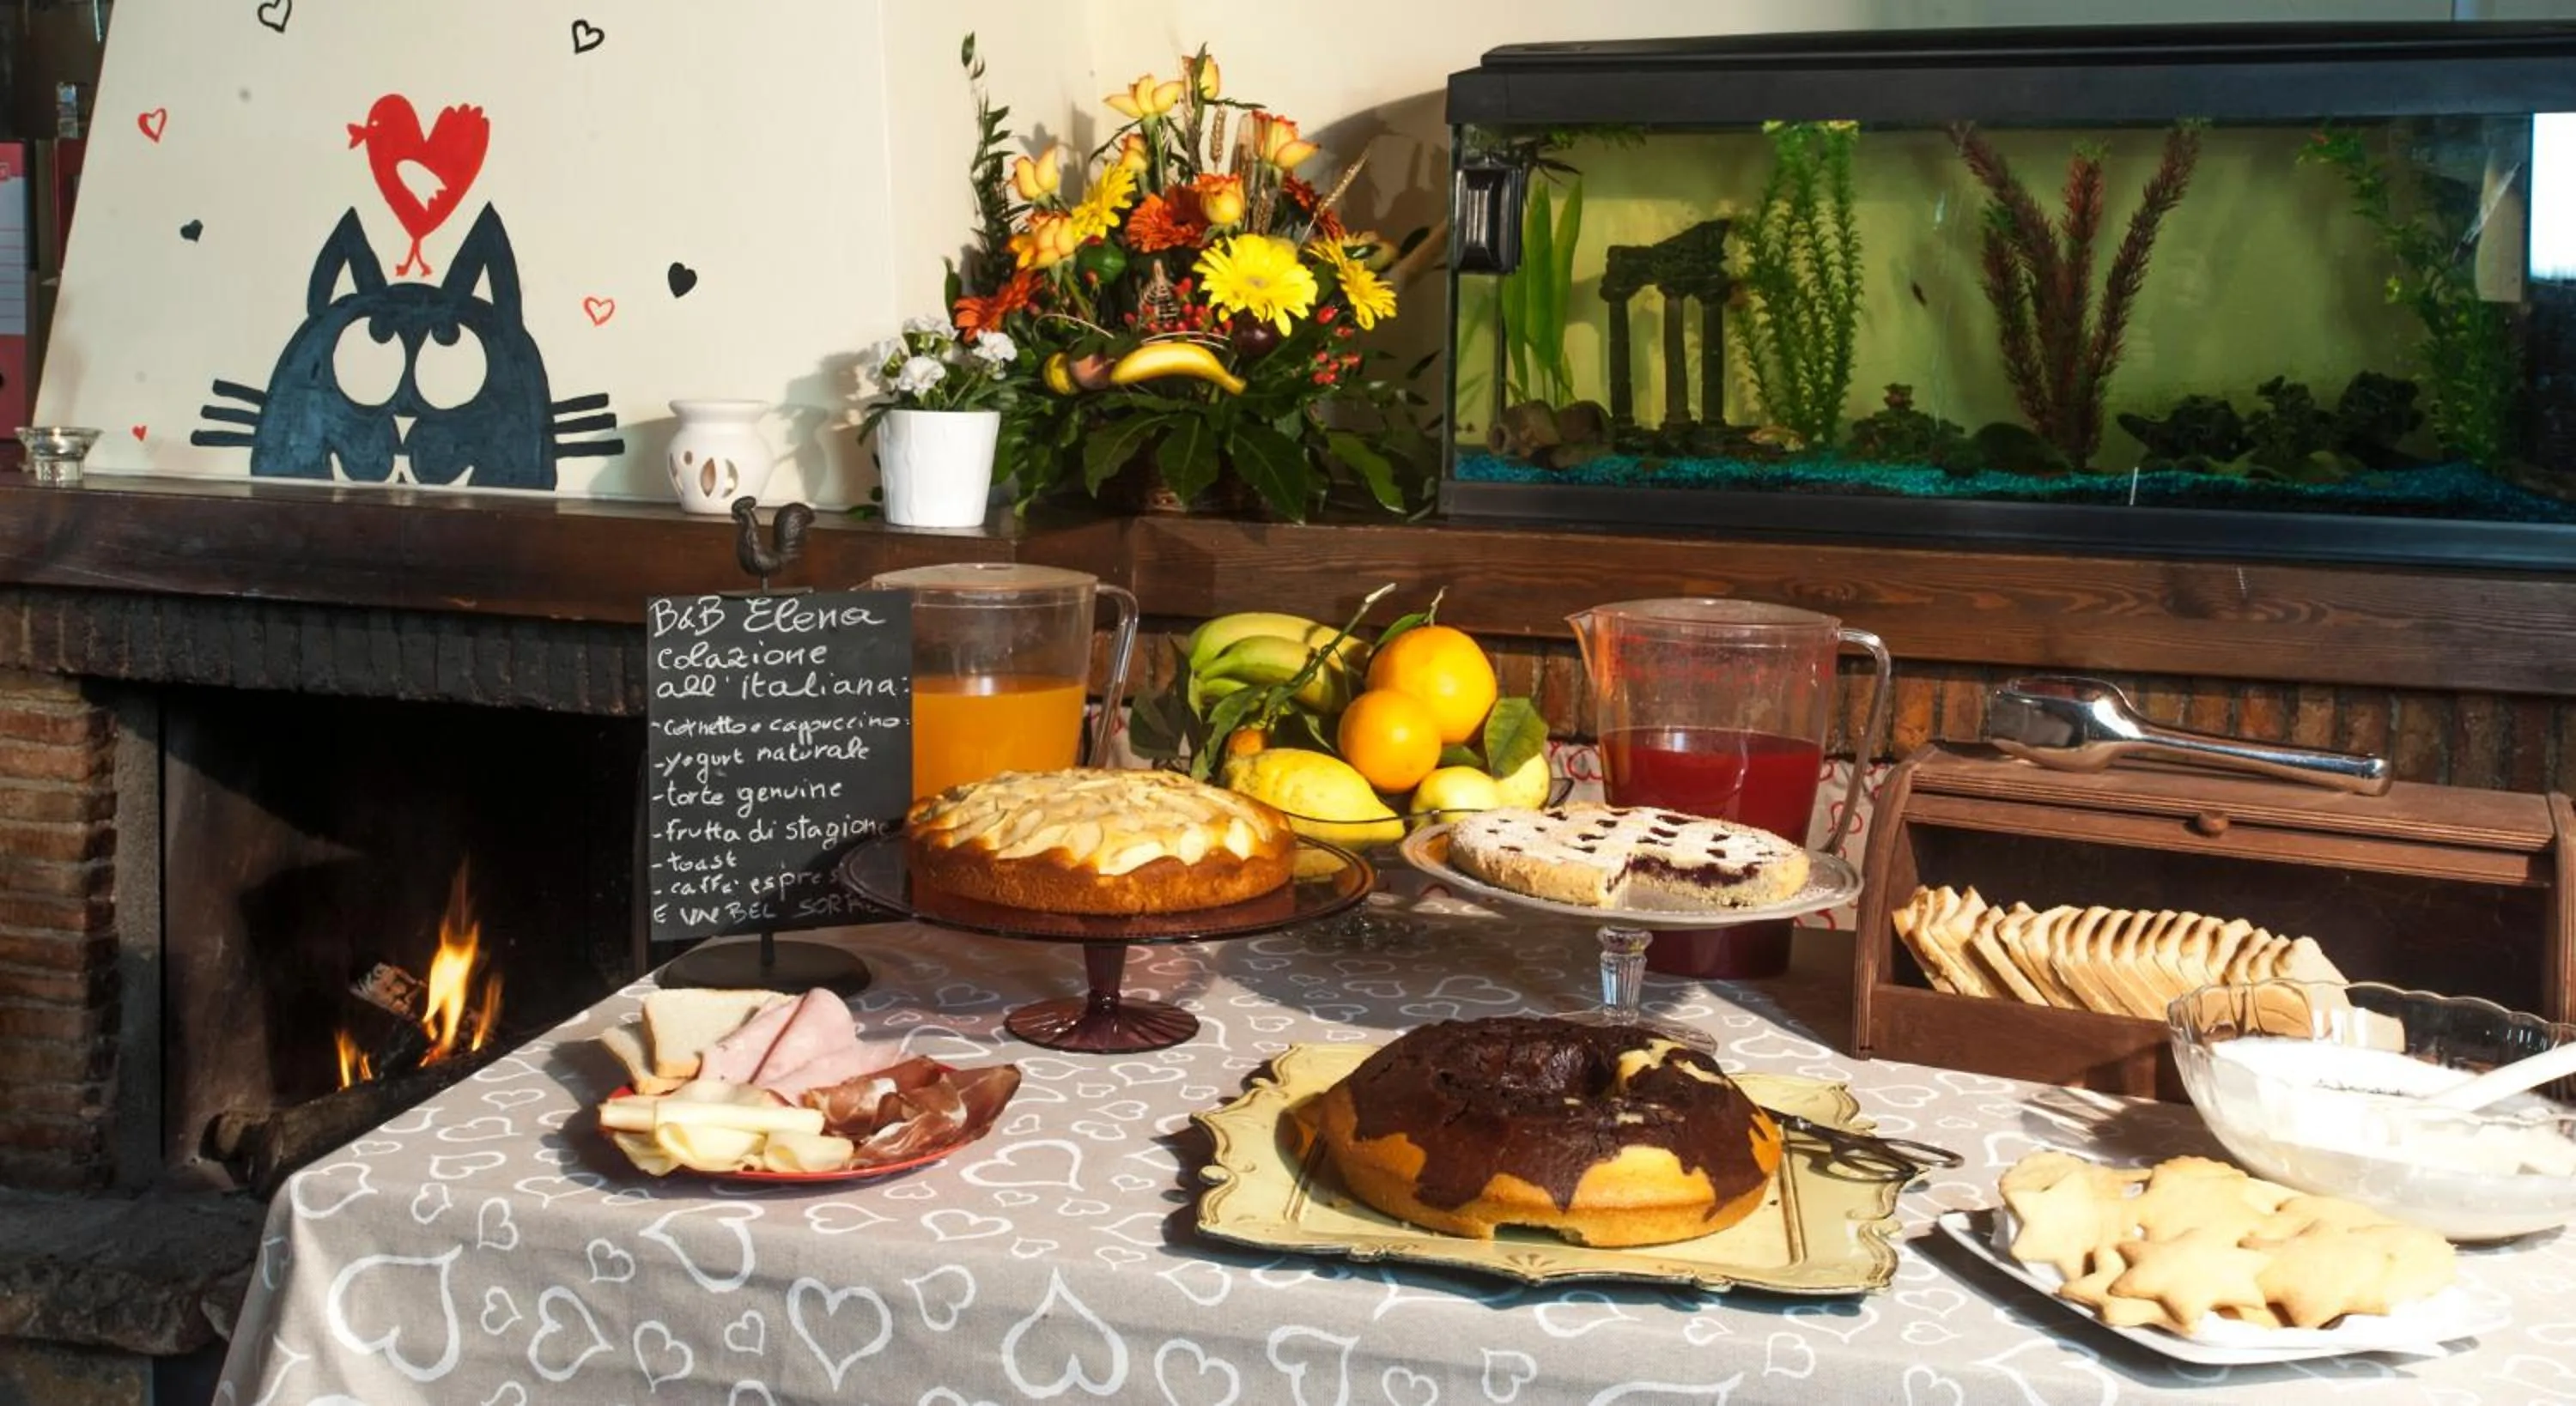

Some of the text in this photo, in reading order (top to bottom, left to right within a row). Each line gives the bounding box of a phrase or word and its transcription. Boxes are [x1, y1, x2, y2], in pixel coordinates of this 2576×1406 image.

[648, 595, 886, 638] B&B Elena
[756, 736, 871, 761] naturale
[736, 778, 843, 818] genuine
[748, 818, 777, 844] di
[785, 813, 890, 851] stagione
[749, 860, 840, 901] espres
[725, 900, 777, 924] BEL
